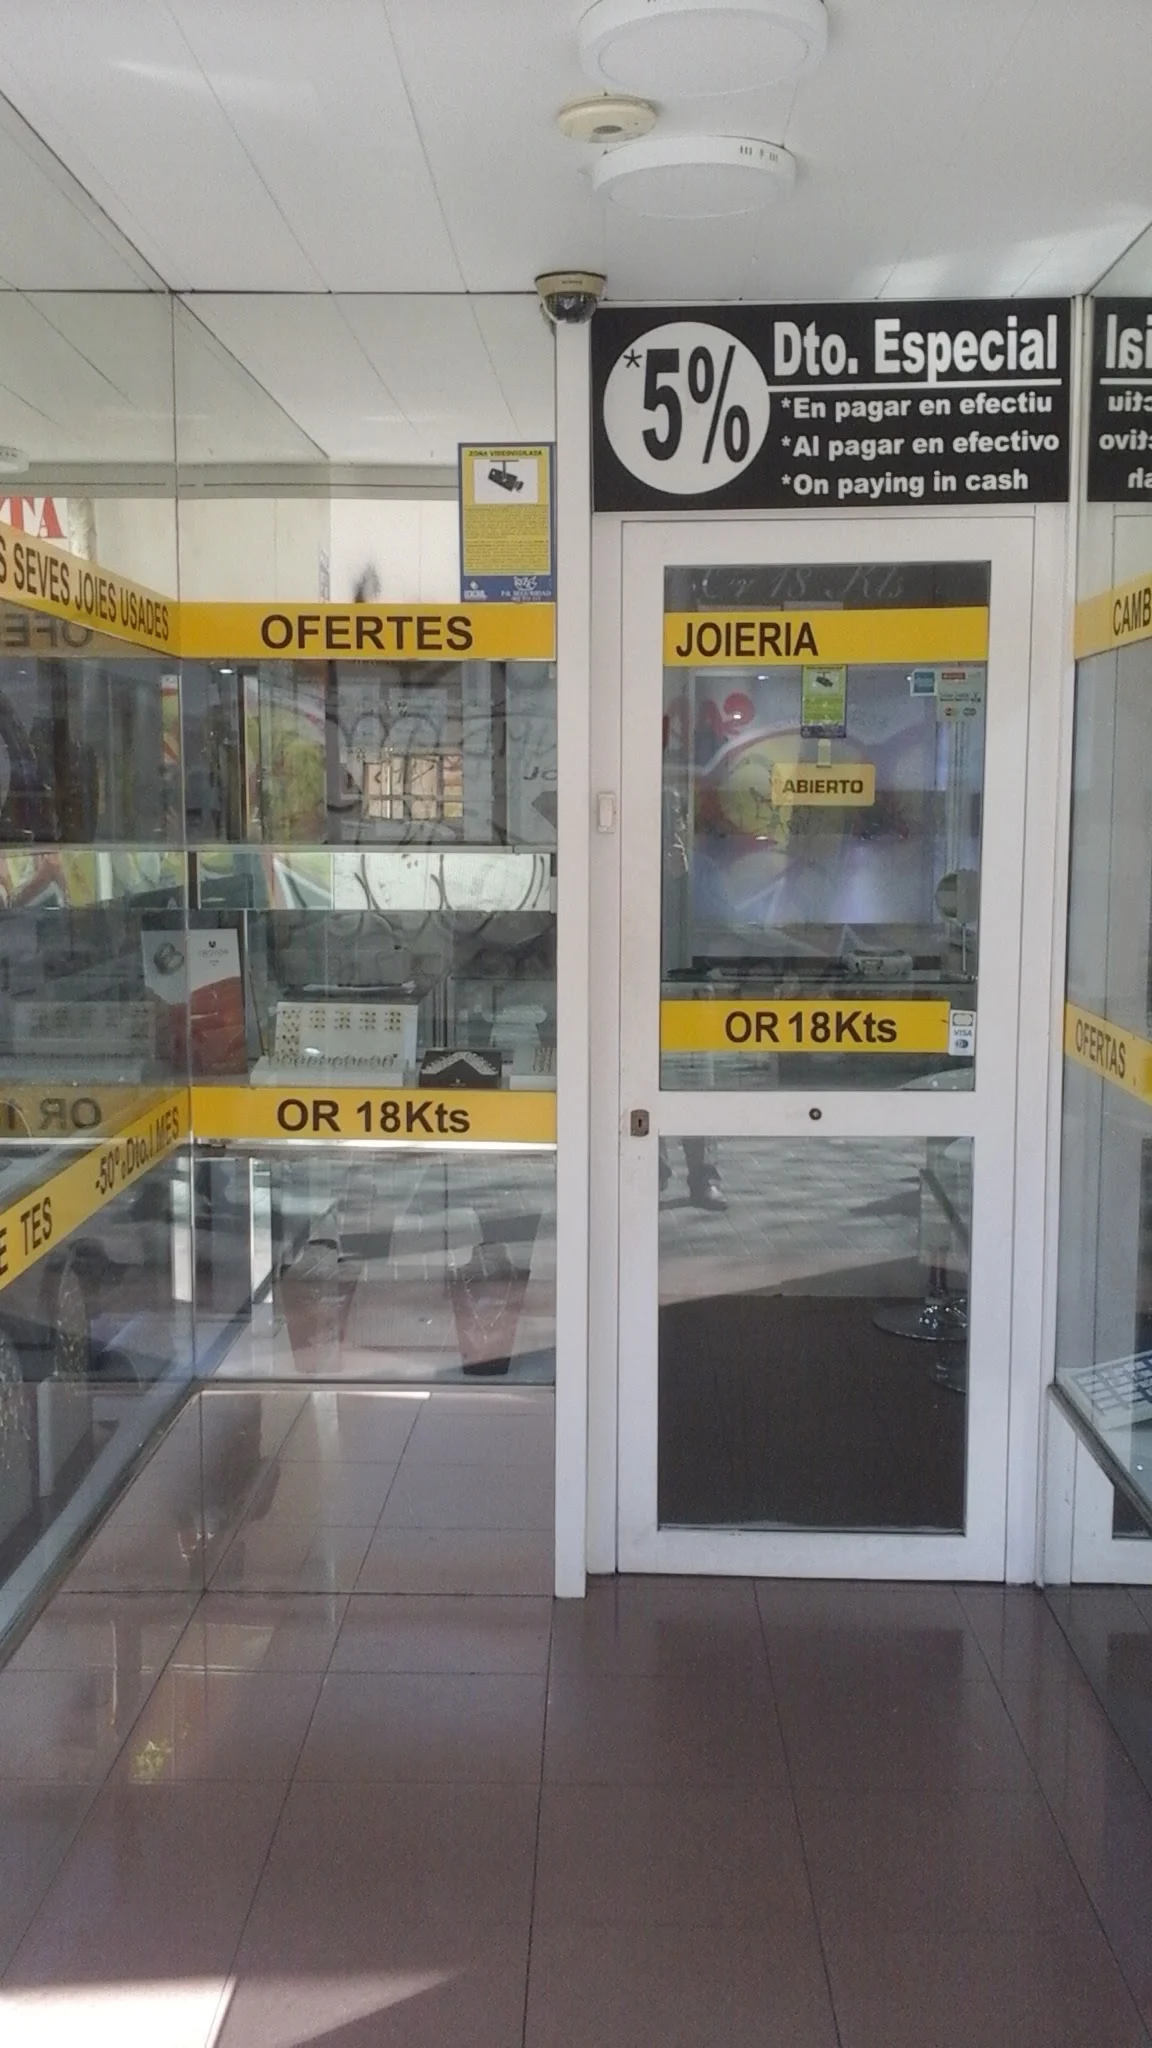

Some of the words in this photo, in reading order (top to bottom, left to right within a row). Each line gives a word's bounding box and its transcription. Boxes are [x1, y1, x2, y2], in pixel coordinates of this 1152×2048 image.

[773, 319, 859, 376] Dto.
[874, 314, 1057, 382] Especial
[835, 397, 911, 424] pagar
[918, 398, 951, 416] en
[960, 392, 1052, 415] efectiu
[829, 436, 904, 463] pagar
[912, 435, 944, 454] en
[953, 431, 1060, 454] efectivo
[838, 472, 924, 499] paying
[933, 470, 957, 492] in
[965, 467, 1028, 490] cash
[13, 543, 70, 606] SEVES
[75, 569, 117, 624] JOIES
[120, 587, 170, 642] USADES
[261, 614, 474, 651] OFERTES
[676, 621, 819, 658] JOIERIA
[783, 778, 864, 795] ABIERTO
[953, 1029, 973, 1037] VISA
[1075, 1019, 1126, 1079] OFERTAS
[276, 1099, 341, 1133] OR
[356, 1099, 470, 1134] 18Kts
